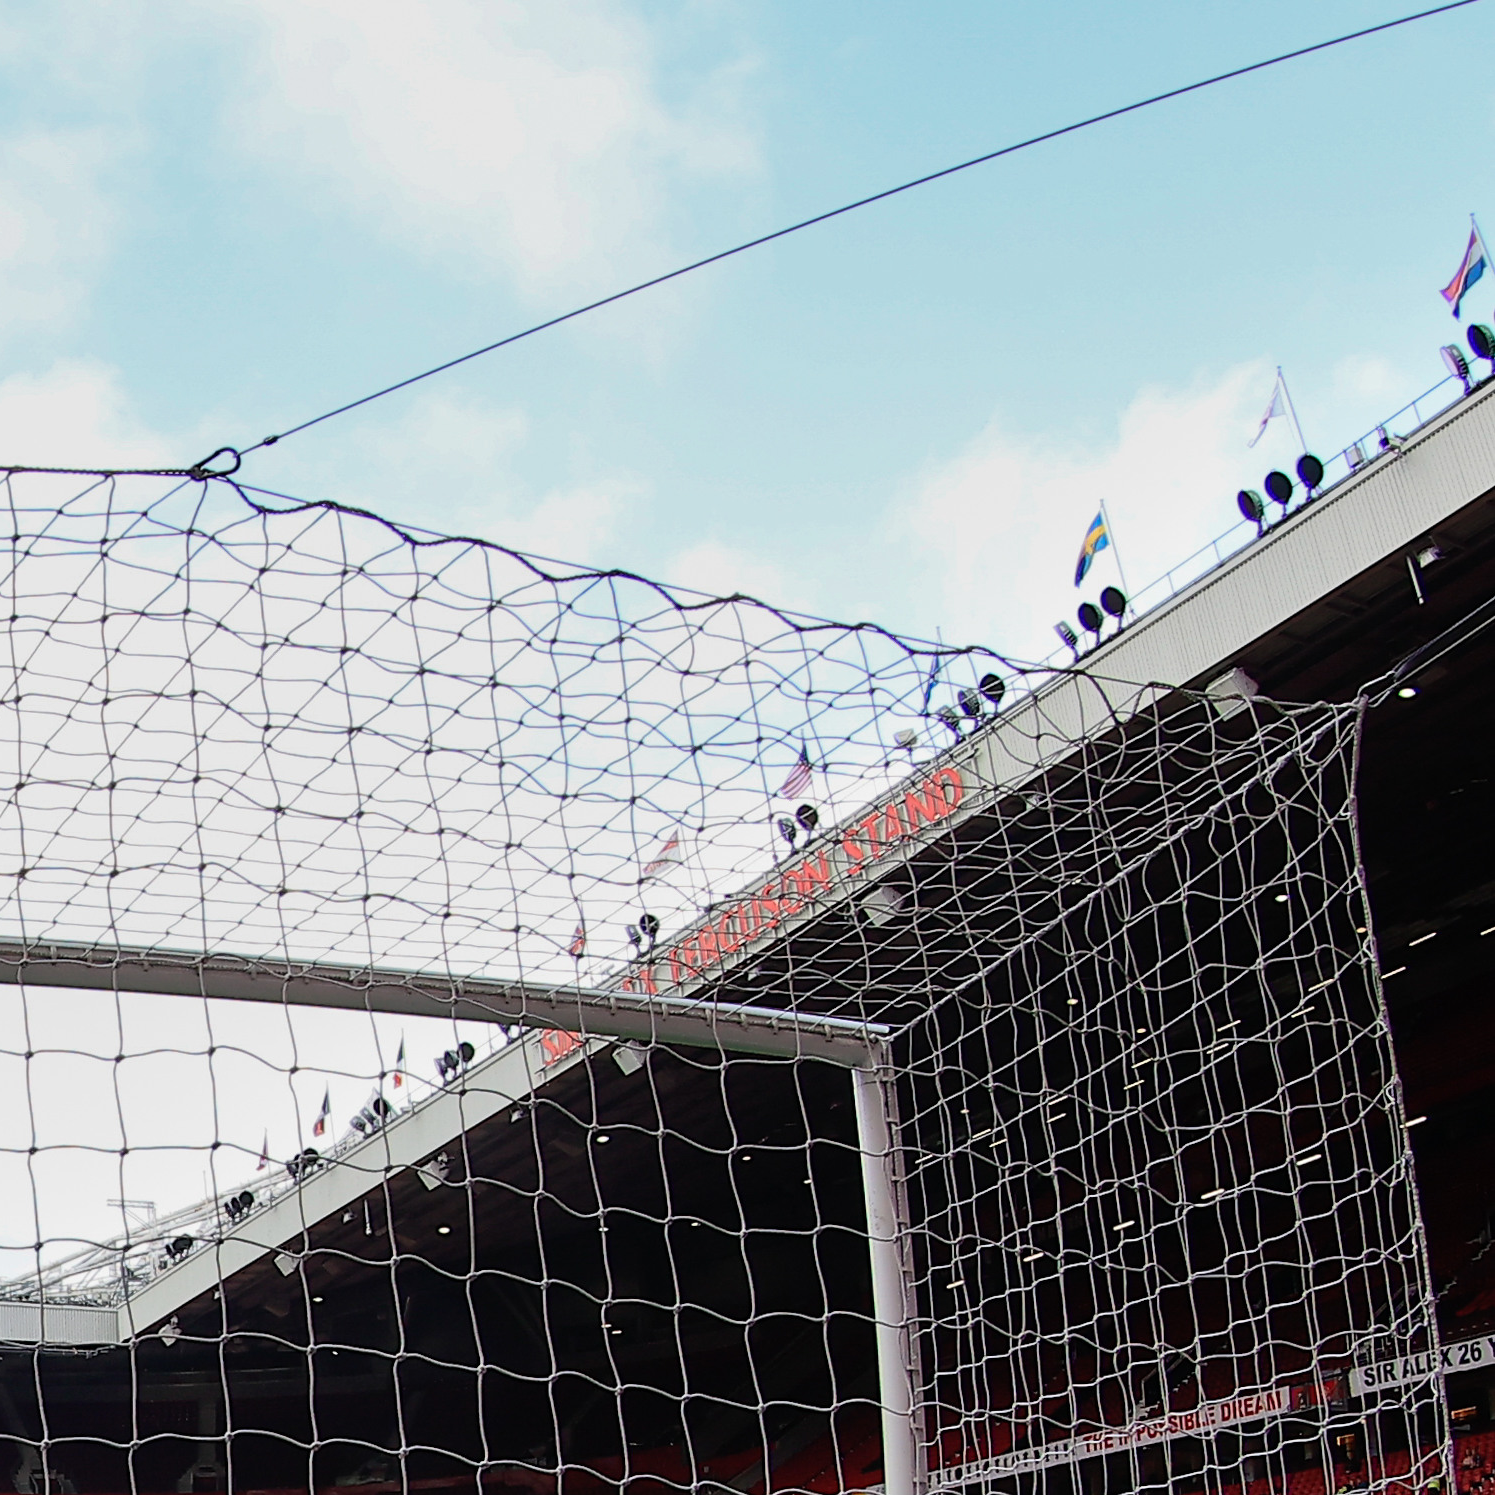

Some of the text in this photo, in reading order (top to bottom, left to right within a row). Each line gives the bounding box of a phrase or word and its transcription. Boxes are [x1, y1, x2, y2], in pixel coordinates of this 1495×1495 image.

[843, 767, 963, 876] STAND
[1363, 1363, 1397, 1387] SIR
[1402, 1346, 1453, 1379] ALEX
[1459, 1341, 1483, 1364] 26
[1220, 1390, 1282, 1422] DREAM
